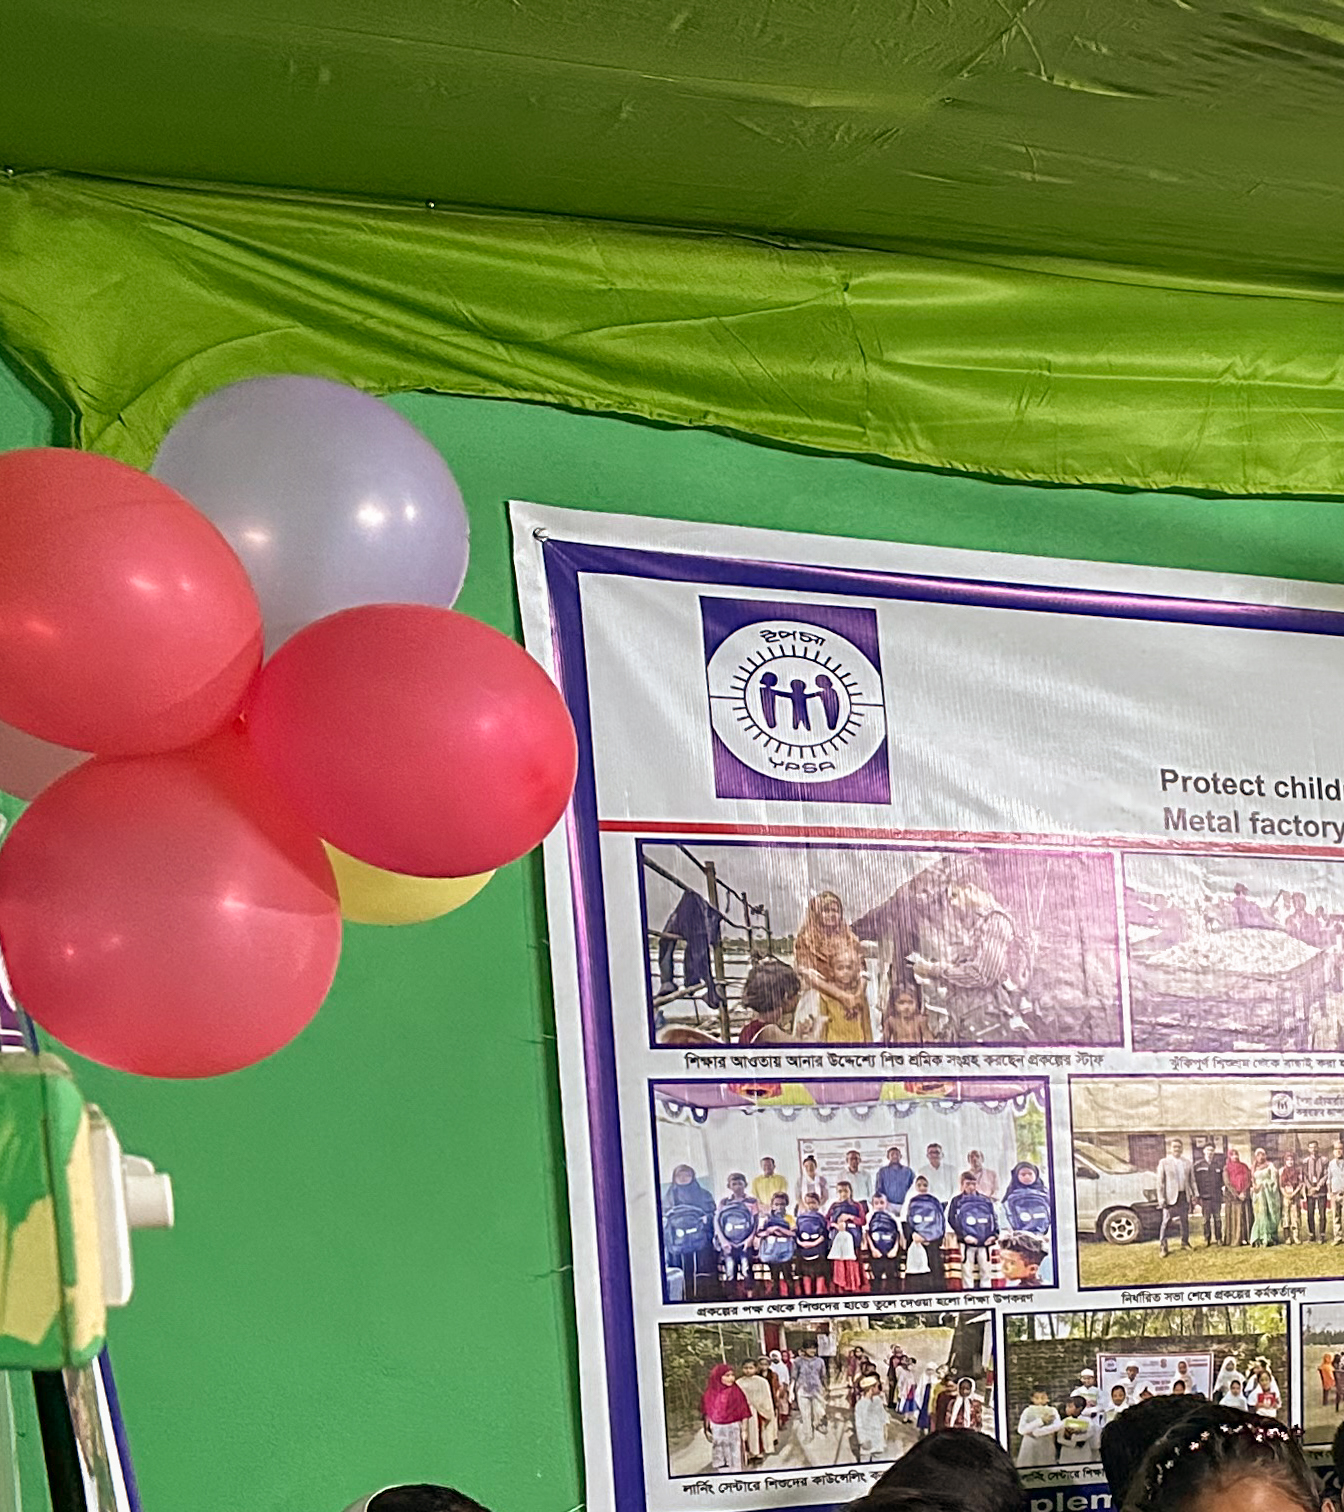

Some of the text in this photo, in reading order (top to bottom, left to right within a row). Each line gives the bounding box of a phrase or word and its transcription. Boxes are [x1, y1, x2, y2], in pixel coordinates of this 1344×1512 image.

[769, 757, 836, 773] YPSA
[1160, 768, 1266, 798] Protect
[1163, 807, 1240, 833] Metal
[786, 1055, 823, 1069] আনার
